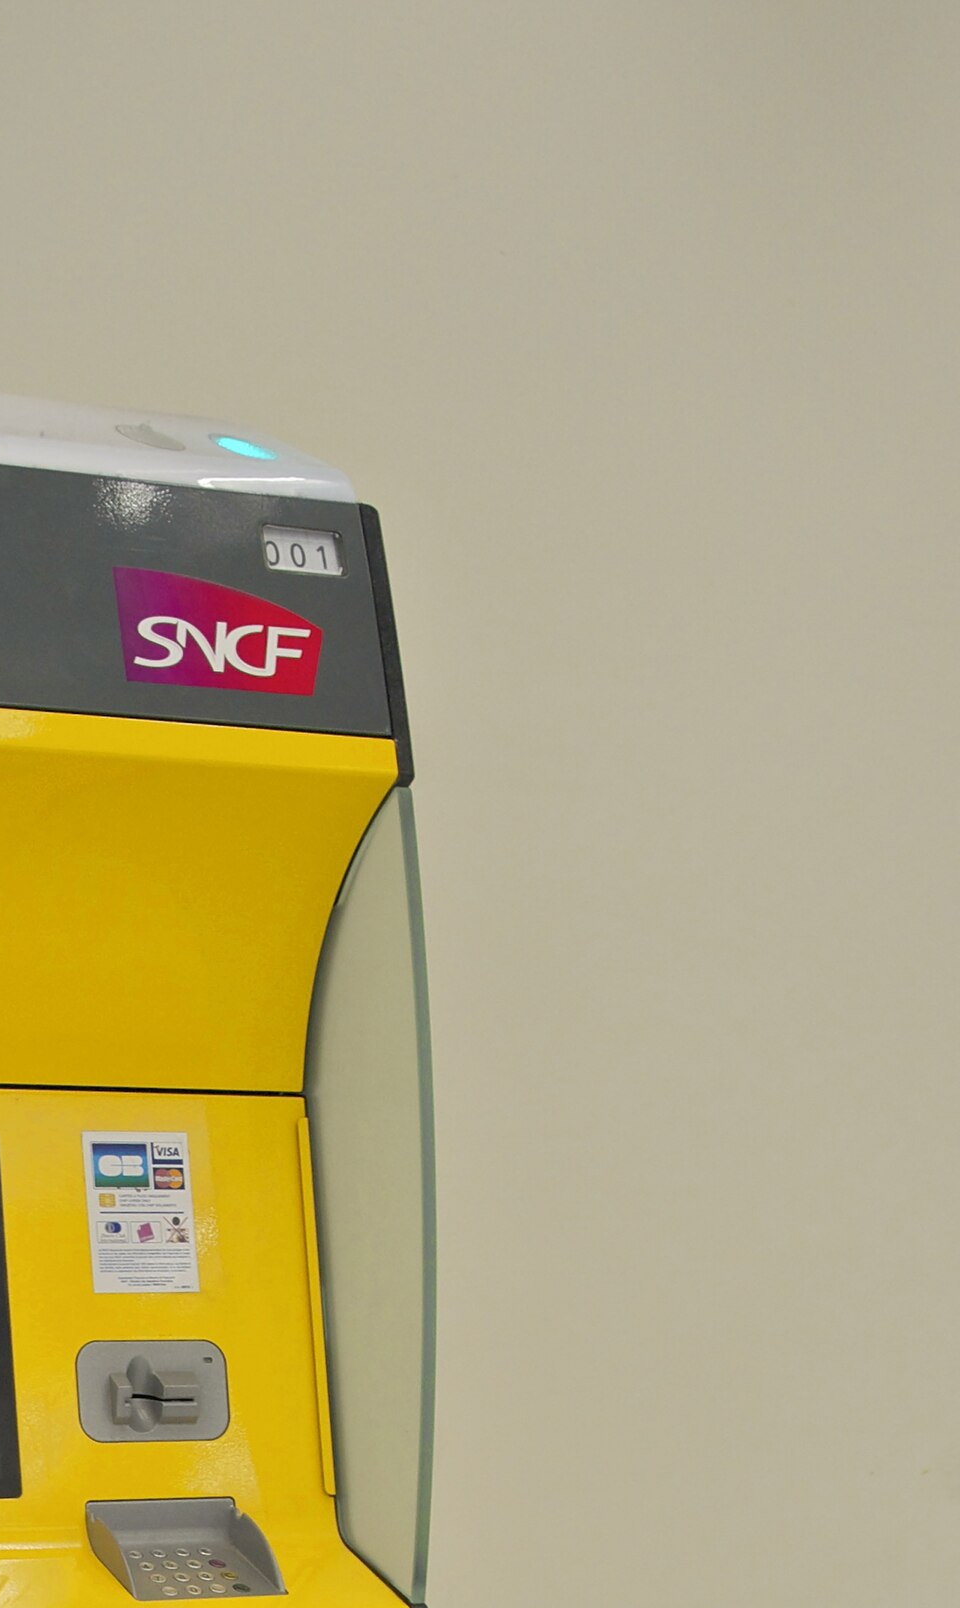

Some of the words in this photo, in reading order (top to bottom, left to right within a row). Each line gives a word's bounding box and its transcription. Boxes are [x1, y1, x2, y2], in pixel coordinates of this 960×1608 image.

[265, 540, 328, 570] 001
[133, 616, 312, 677] SNCF
[154, 1144, 180, 1157] VISA
